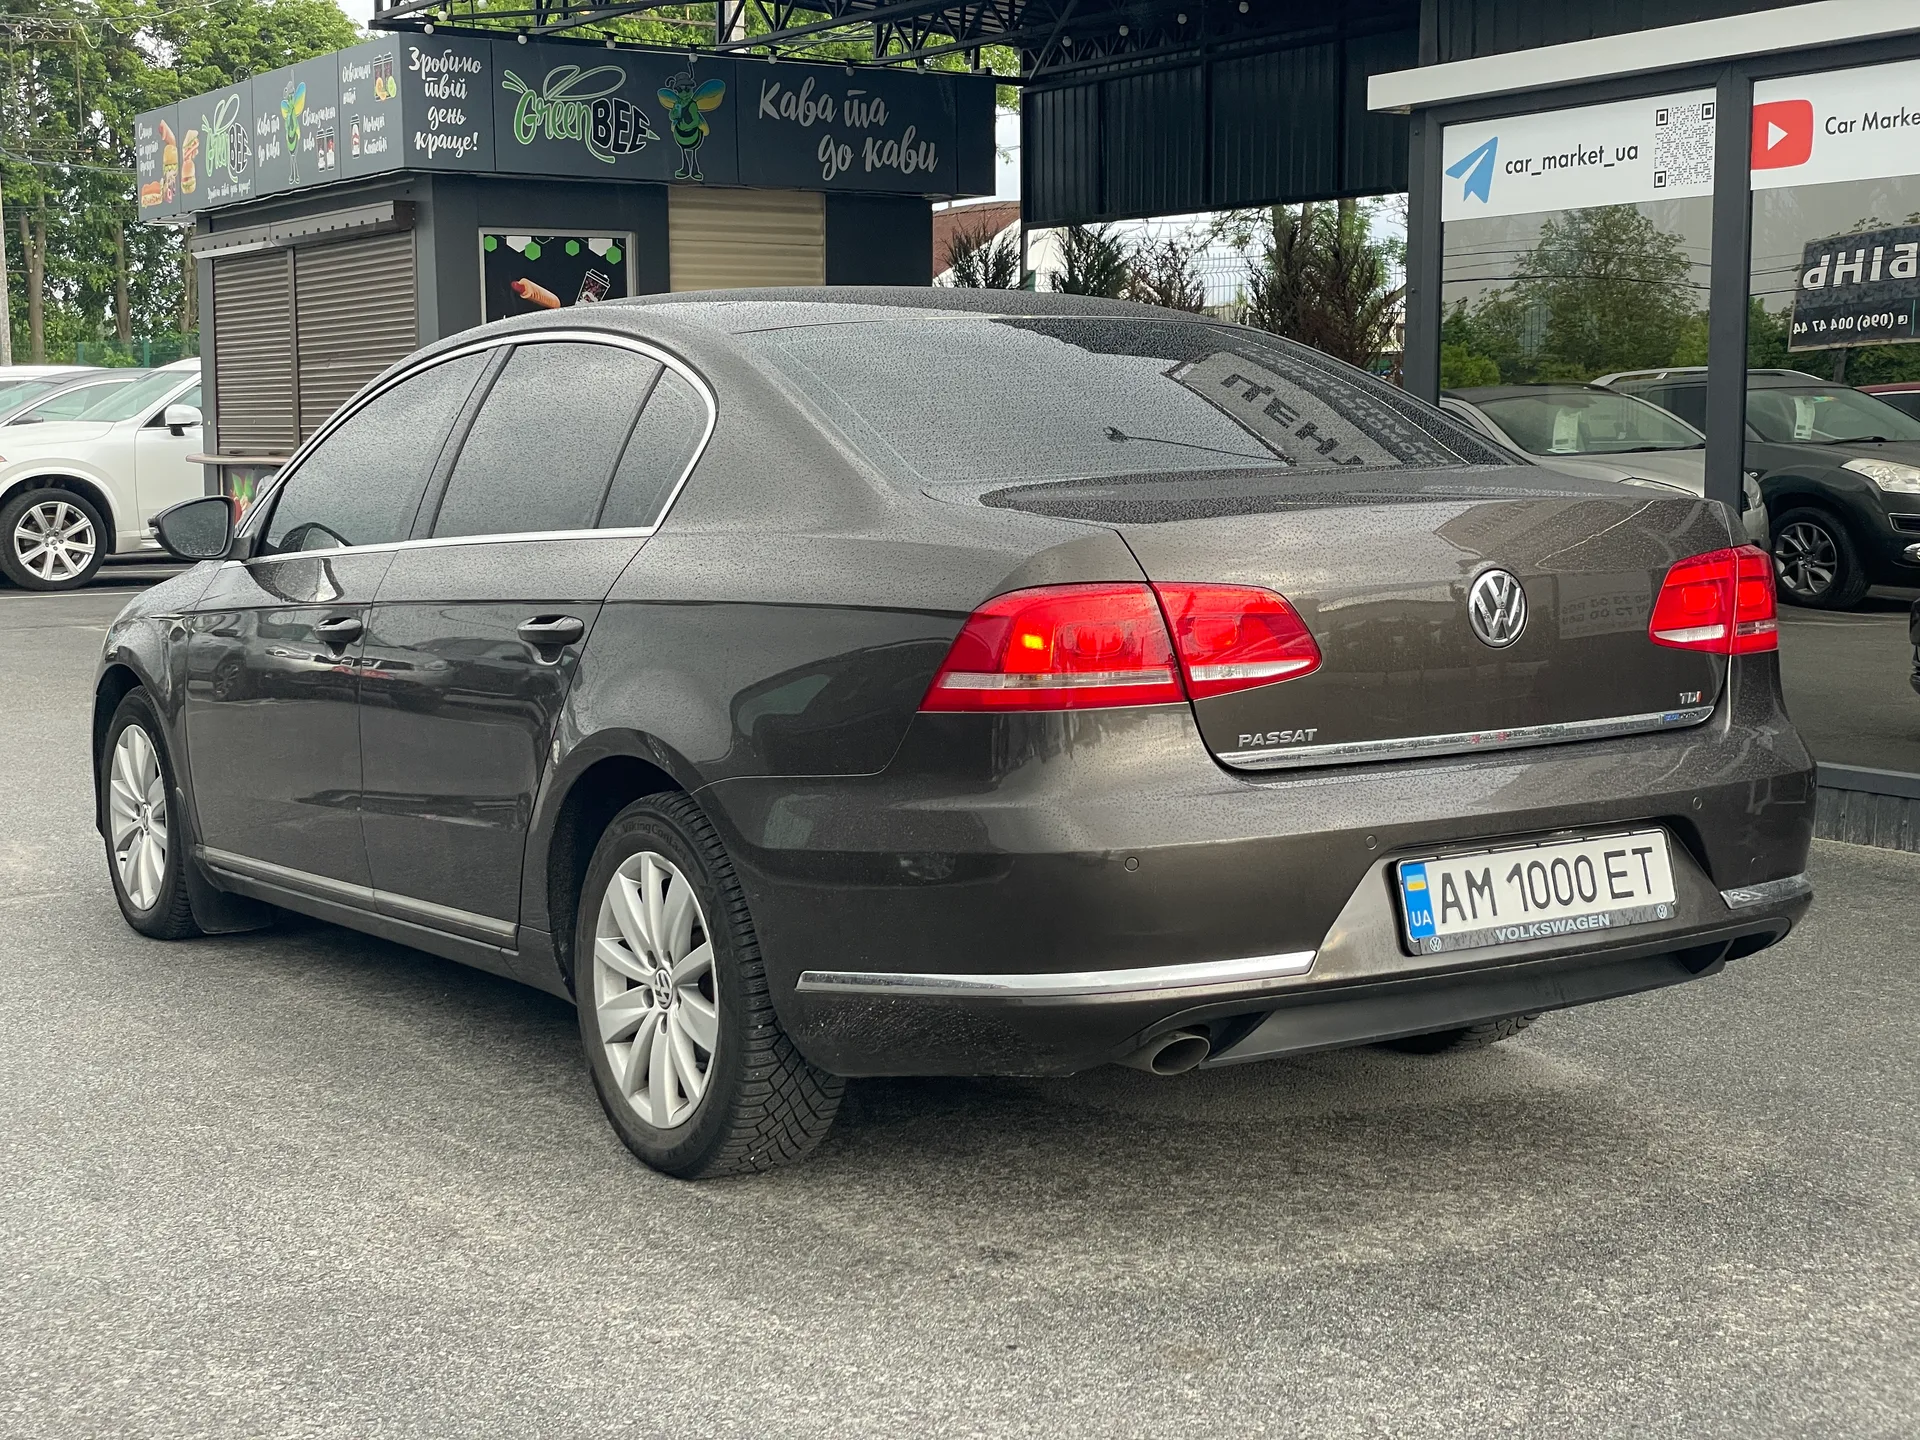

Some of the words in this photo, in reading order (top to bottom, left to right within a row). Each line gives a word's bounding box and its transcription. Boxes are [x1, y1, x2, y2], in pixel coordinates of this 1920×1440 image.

[408, 46, 482, 80] Зробимо
[424, 73, 468, 99] твій
[758, 76, 838, 127] Кава
[844, 89, 889, 128] та
[427, 106, 467, 131] день
[1825, 115, 1857, 136] Car
[1861, 106, 1920, 132] Marke
[414, 131, 479, 159] краще!
[818, 134, 855, 181] до
[861, 125, 938, 174] кави
[1504, 143, 1639, 177] car_market_ua
[1679, 690, 1703, 705] TDI
[1238, 728, 1318, 748] PASSAT
[1441, 867, 1498, 924] AM
[1506, 854, 1598, 912] 1000
[1603, 846, 1653, 900] ET
[1412, 910, 1433, 927] UA
[1495, 913, 1610, 943] VOLKSWAGEN
